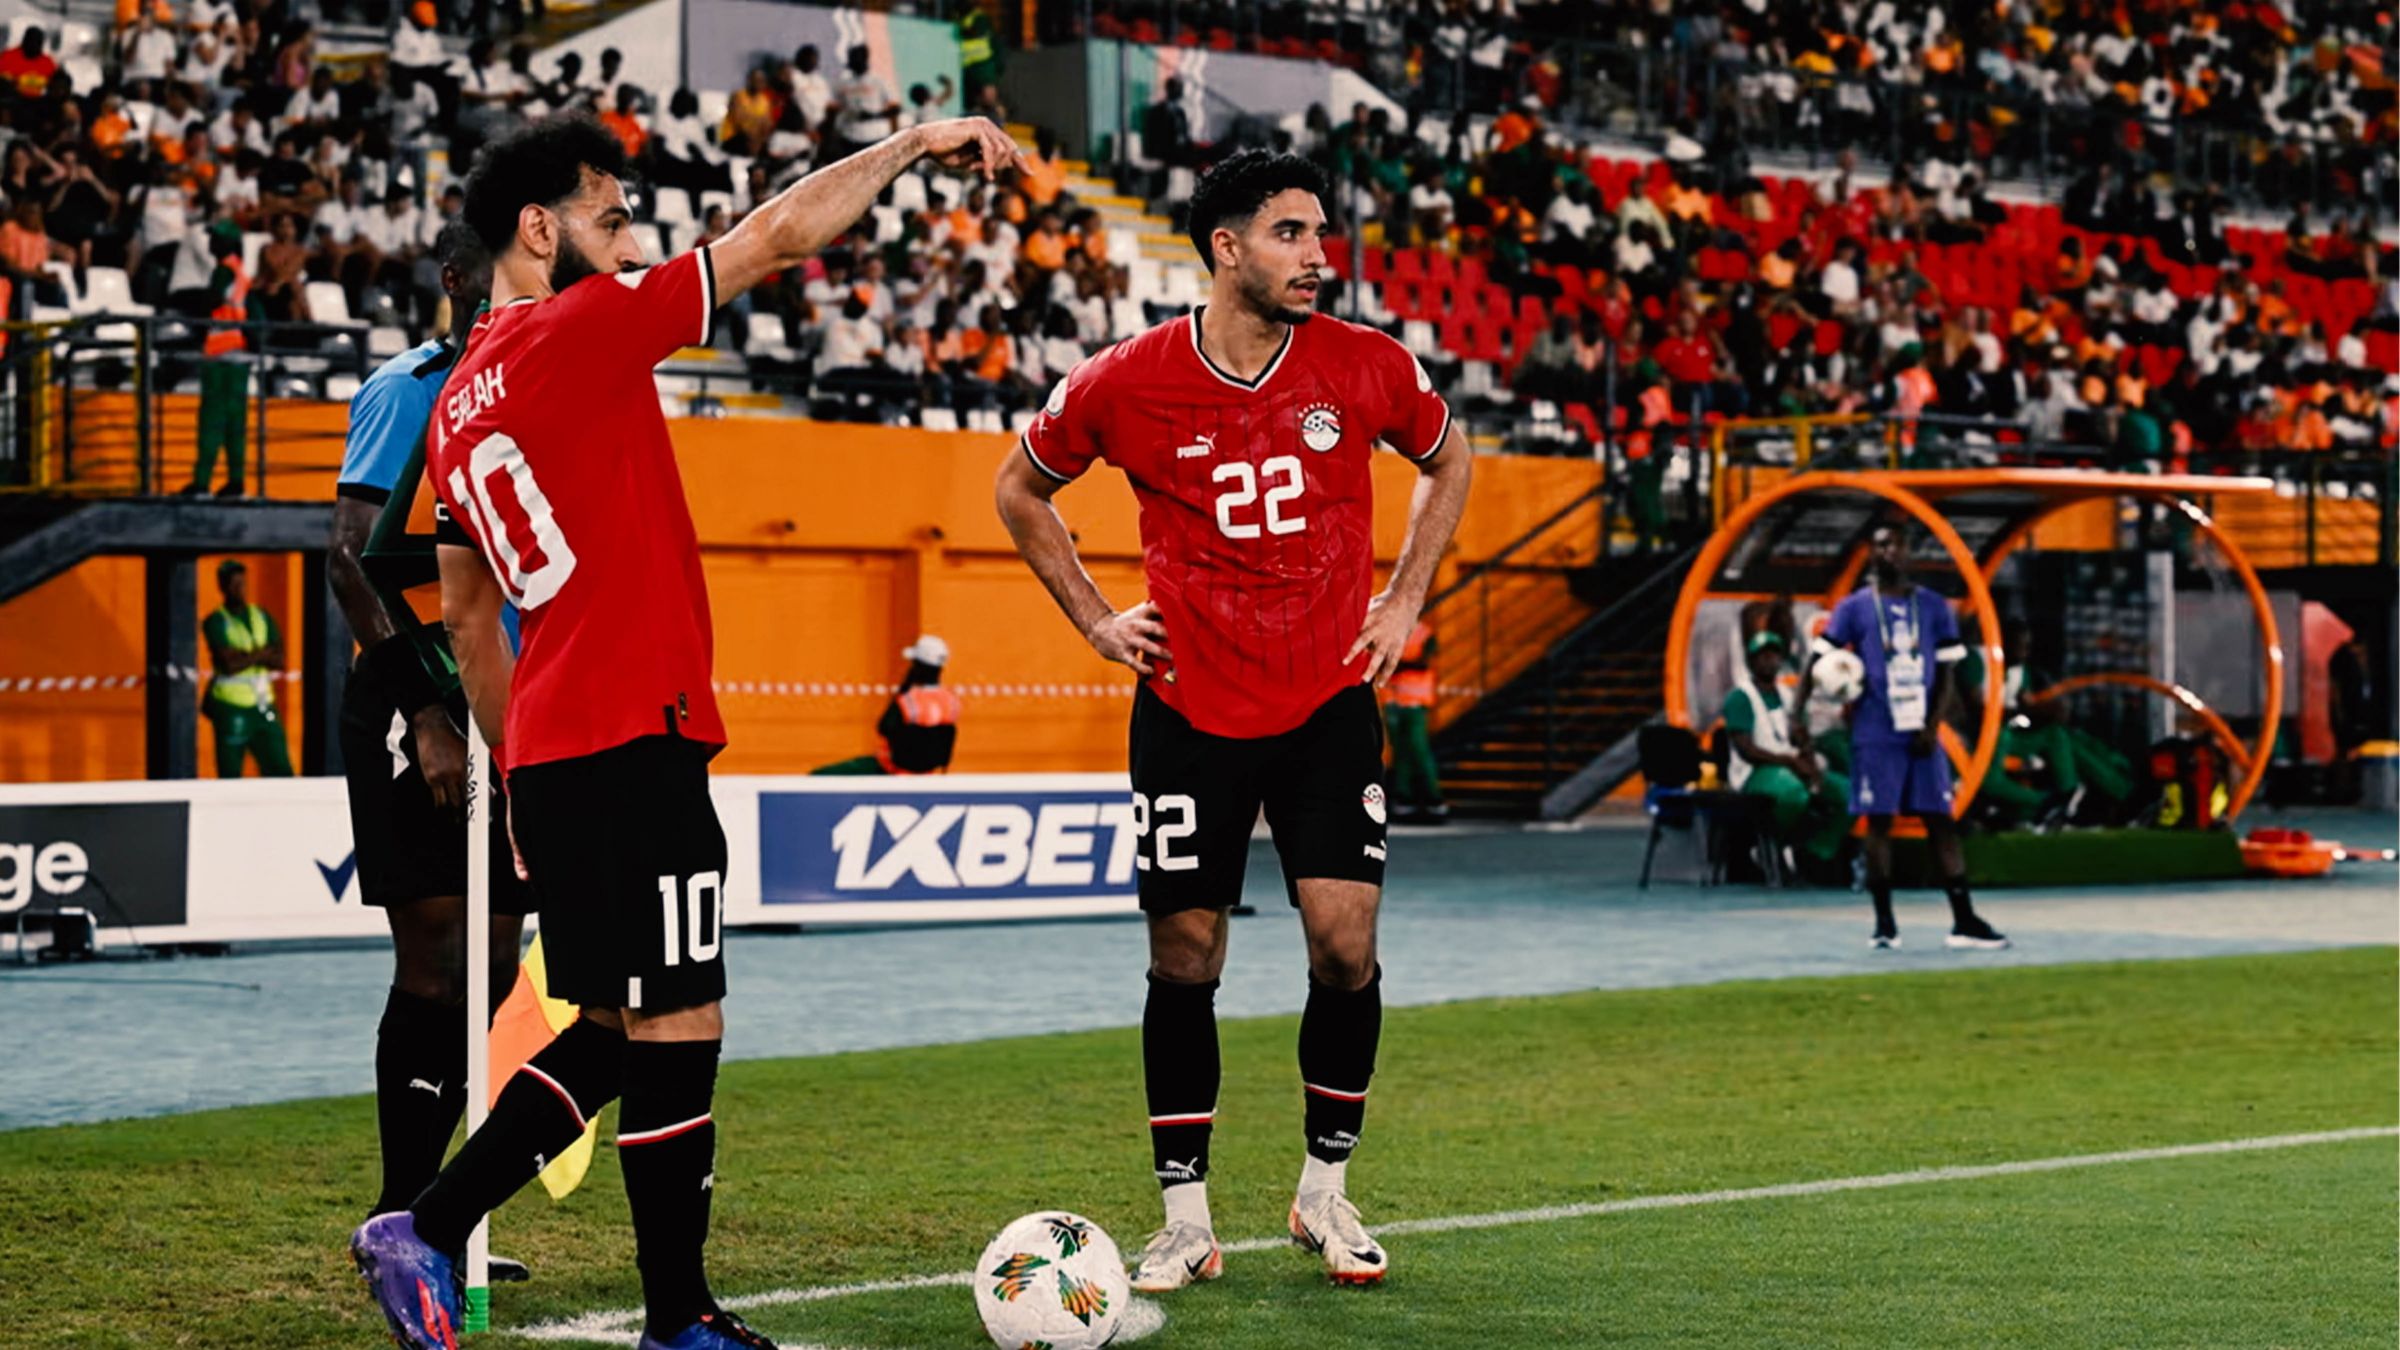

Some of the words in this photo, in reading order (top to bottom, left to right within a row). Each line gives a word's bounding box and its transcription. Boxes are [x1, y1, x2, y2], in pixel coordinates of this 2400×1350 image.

[447, 431, 578, 612] 10
[1211, 454, 1307, 540] 22
[831, 803, 1137, 890] 1XBET
[658, 870, 721, 967] 10
